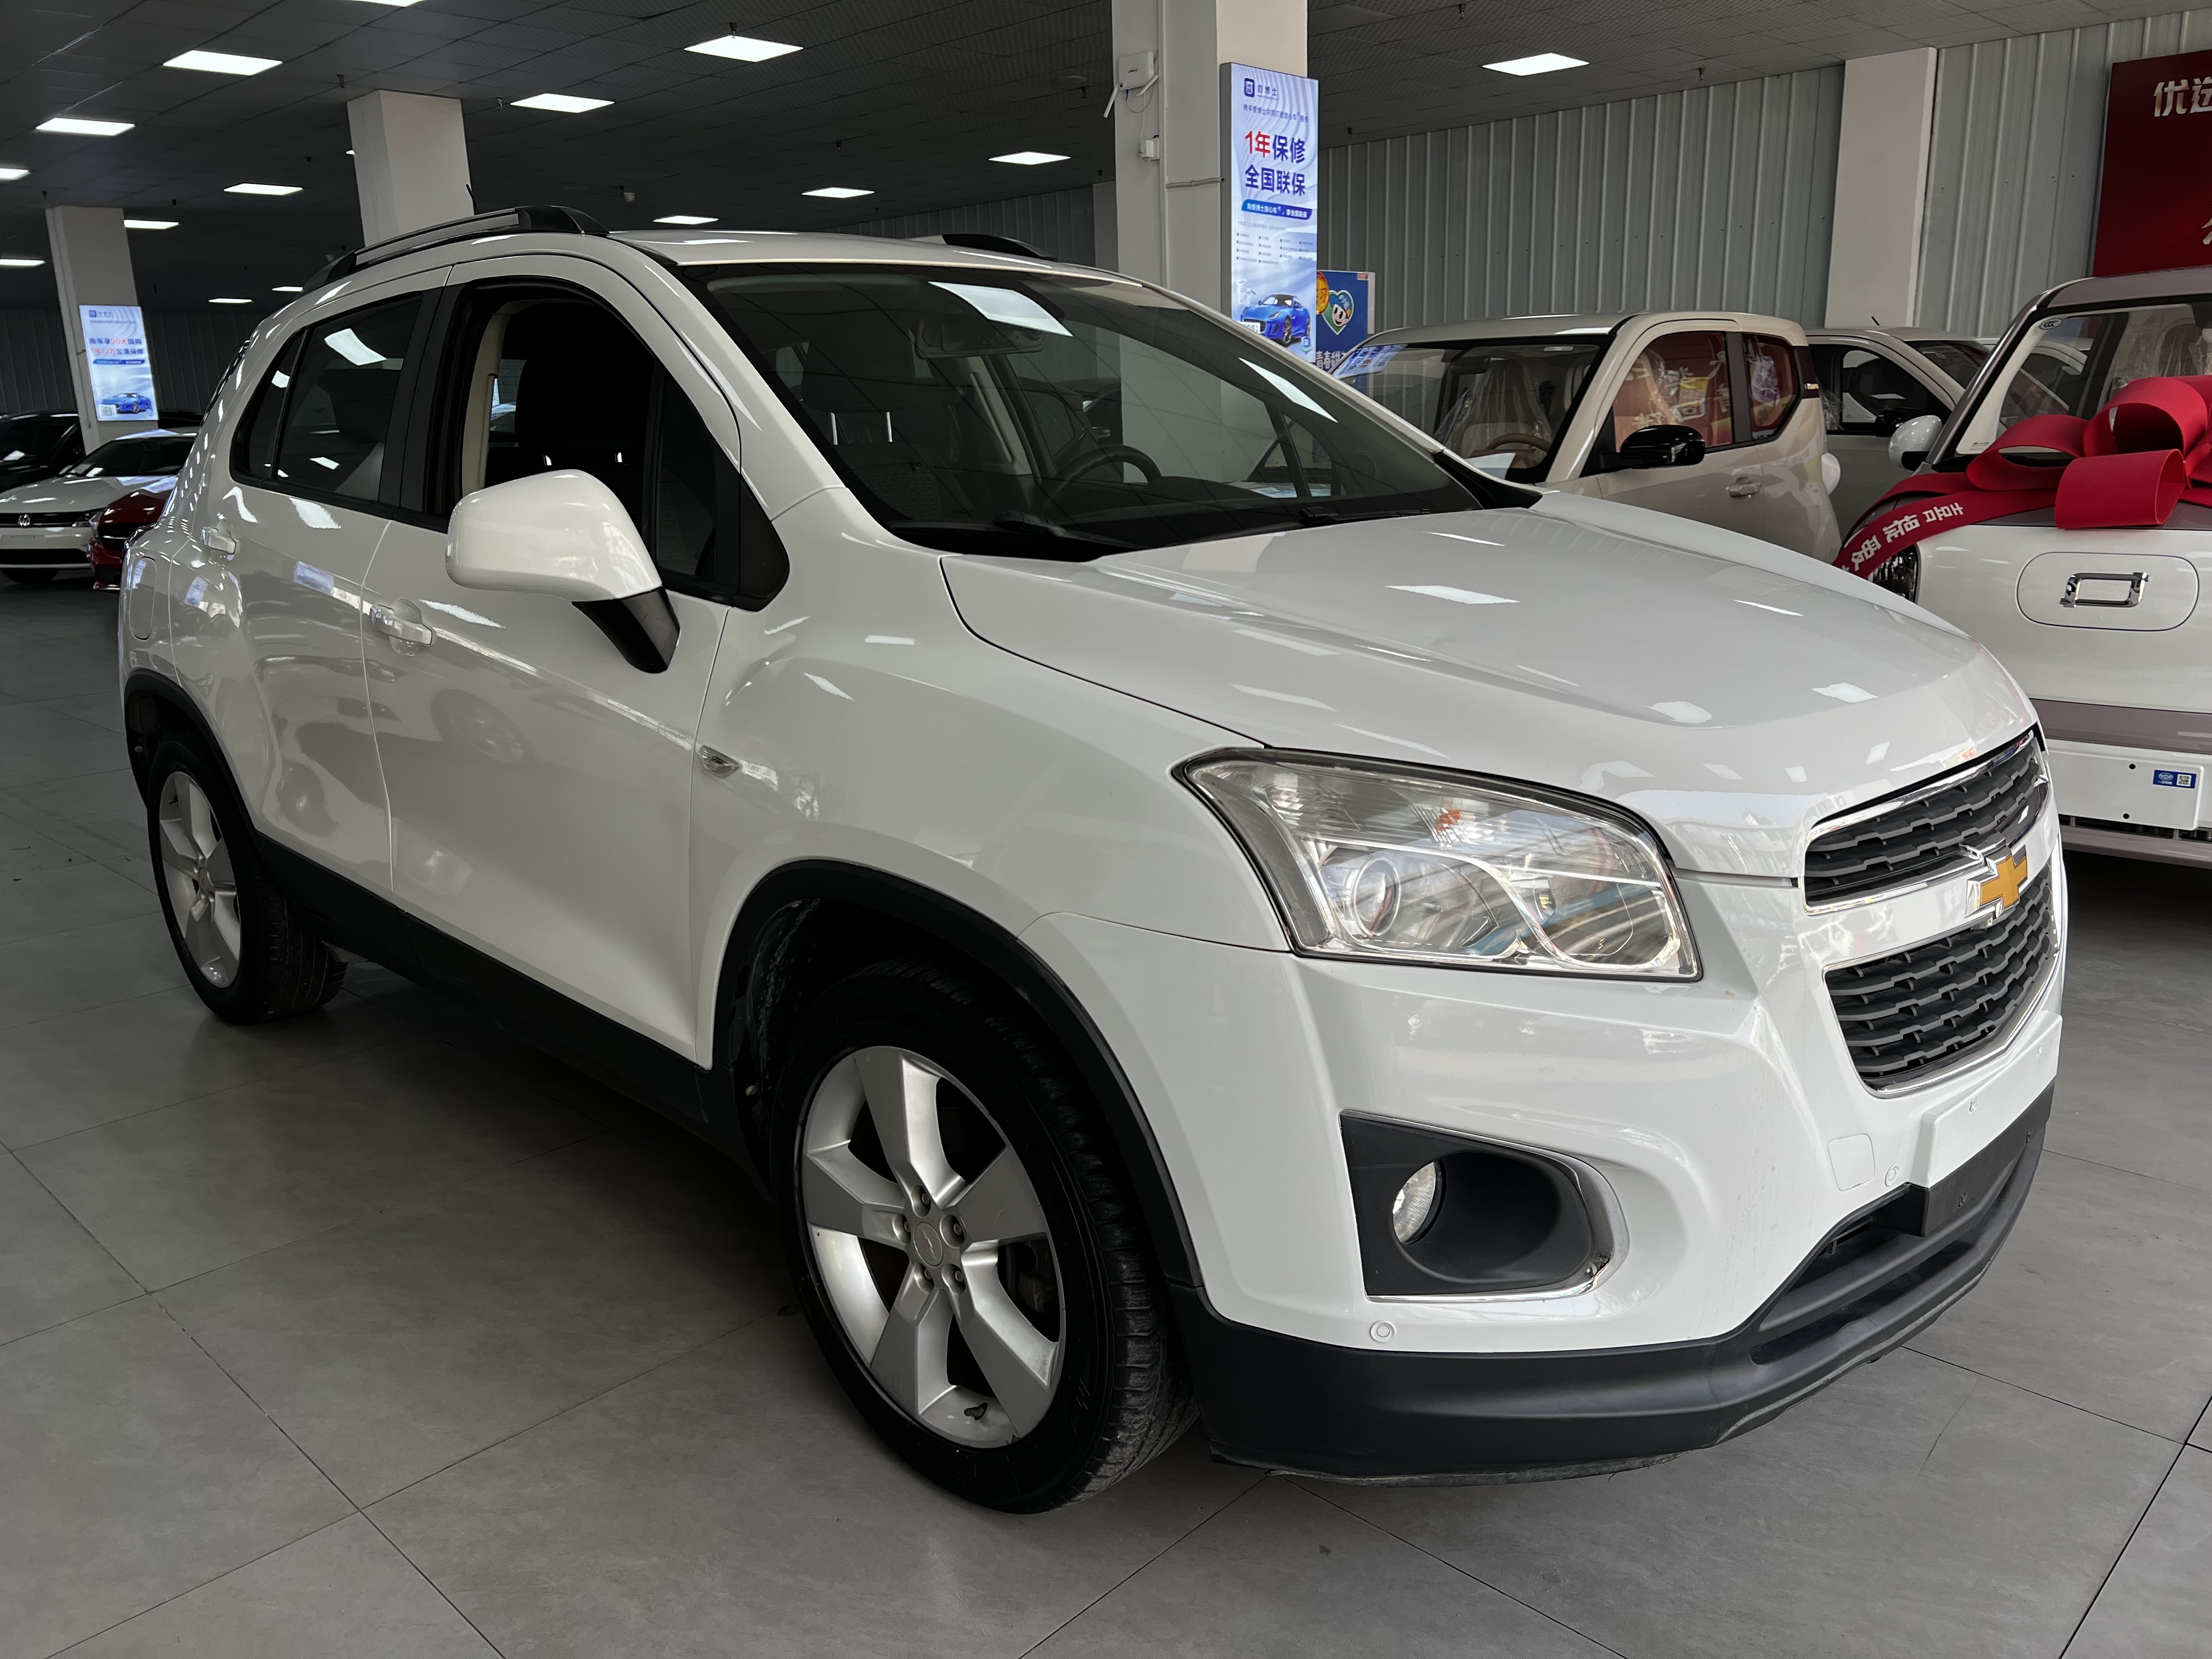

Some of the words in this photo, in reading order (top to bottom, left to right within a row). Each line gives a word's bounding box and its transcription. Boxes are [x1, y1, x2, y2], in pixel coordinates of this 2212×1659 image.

[2153, 76, 2212, 117] 优选
[1245, 131, 1305, 163] 1年保修
[1245, 164, 1306, 196] 全国联保
[1316, 349, 1348, 369] 青春甜
[1841, 502, 1964, 572] 喜提爱
